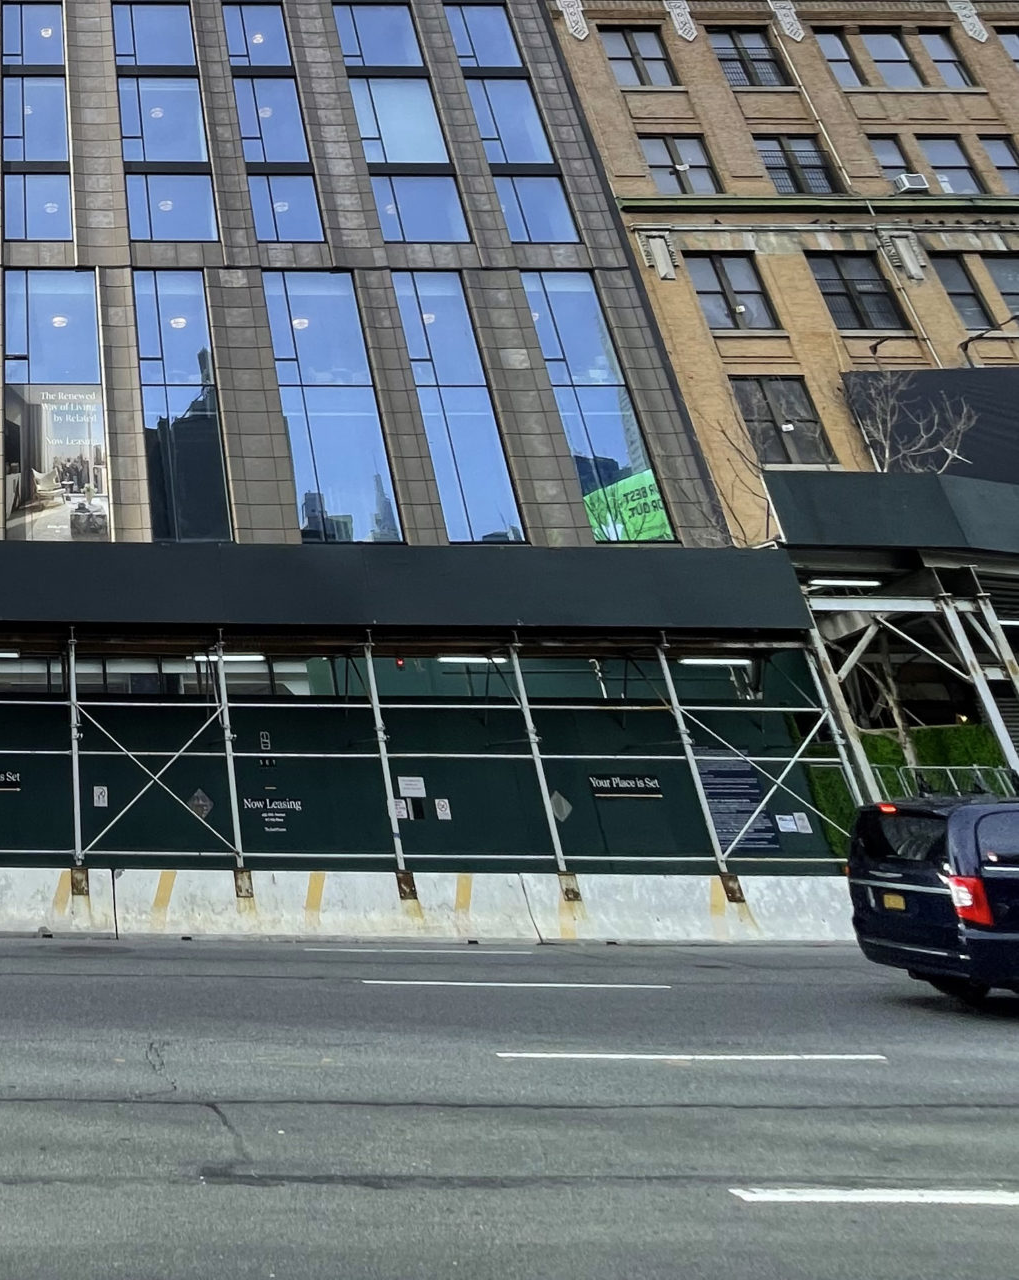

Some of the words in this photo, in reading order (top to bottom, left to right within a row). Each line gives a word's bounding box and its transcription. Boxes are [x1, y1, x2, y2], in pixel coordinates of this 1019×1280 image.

[41, 391, 56, 400] The
[58, 391, 96, 400] Renewed
[60, 402, 69, 411] of
[53, 414, 63, 423] by
[65, 414, 97, 422] Related
[46, 436, 63, 445] Now
[6, 771, 21, 782] Set
[589, 776, 611, 788] Your
[611, 776, 636, 788] Place
[635, 777, 645, 788] is
[644, 777, 660, 788] Set
[243, 798, 265, 809] Now
[266, 798, 302, 811] Leasing
